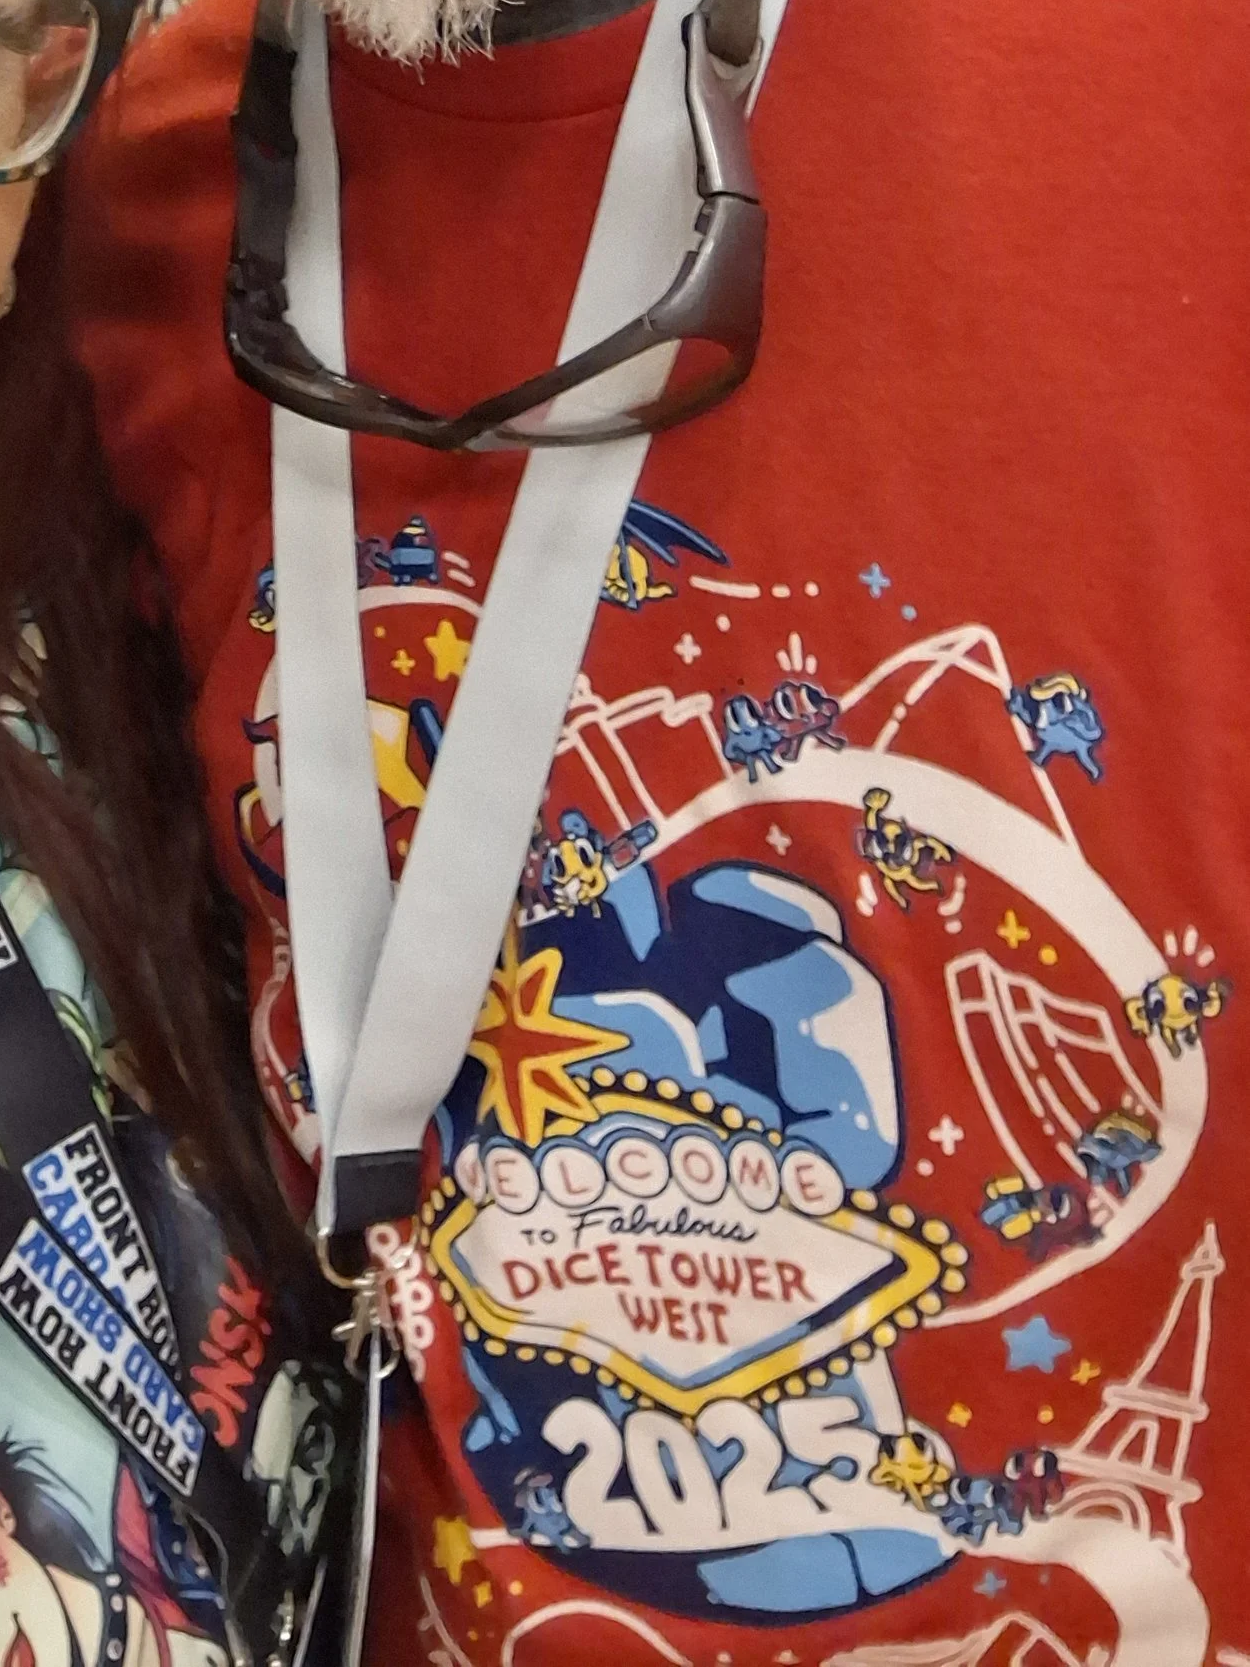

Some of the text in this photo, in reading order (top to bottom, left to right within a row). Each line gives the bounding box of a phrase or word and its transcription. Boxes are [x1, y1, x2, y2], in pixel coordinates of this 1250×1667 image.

[65, 1130, 149, 1282] FRONT
[568, 1204, 757, 1248] Fabulous
[501, 1244, 817, 1303] DICE TOWER
[618, 1291, 732, 1346] WEST
[18, 1229, 202, 1453] CARD SHOW
[84, 1361, 193, 1484] FRONT
[543, 1394, 882, 1537] 2025
